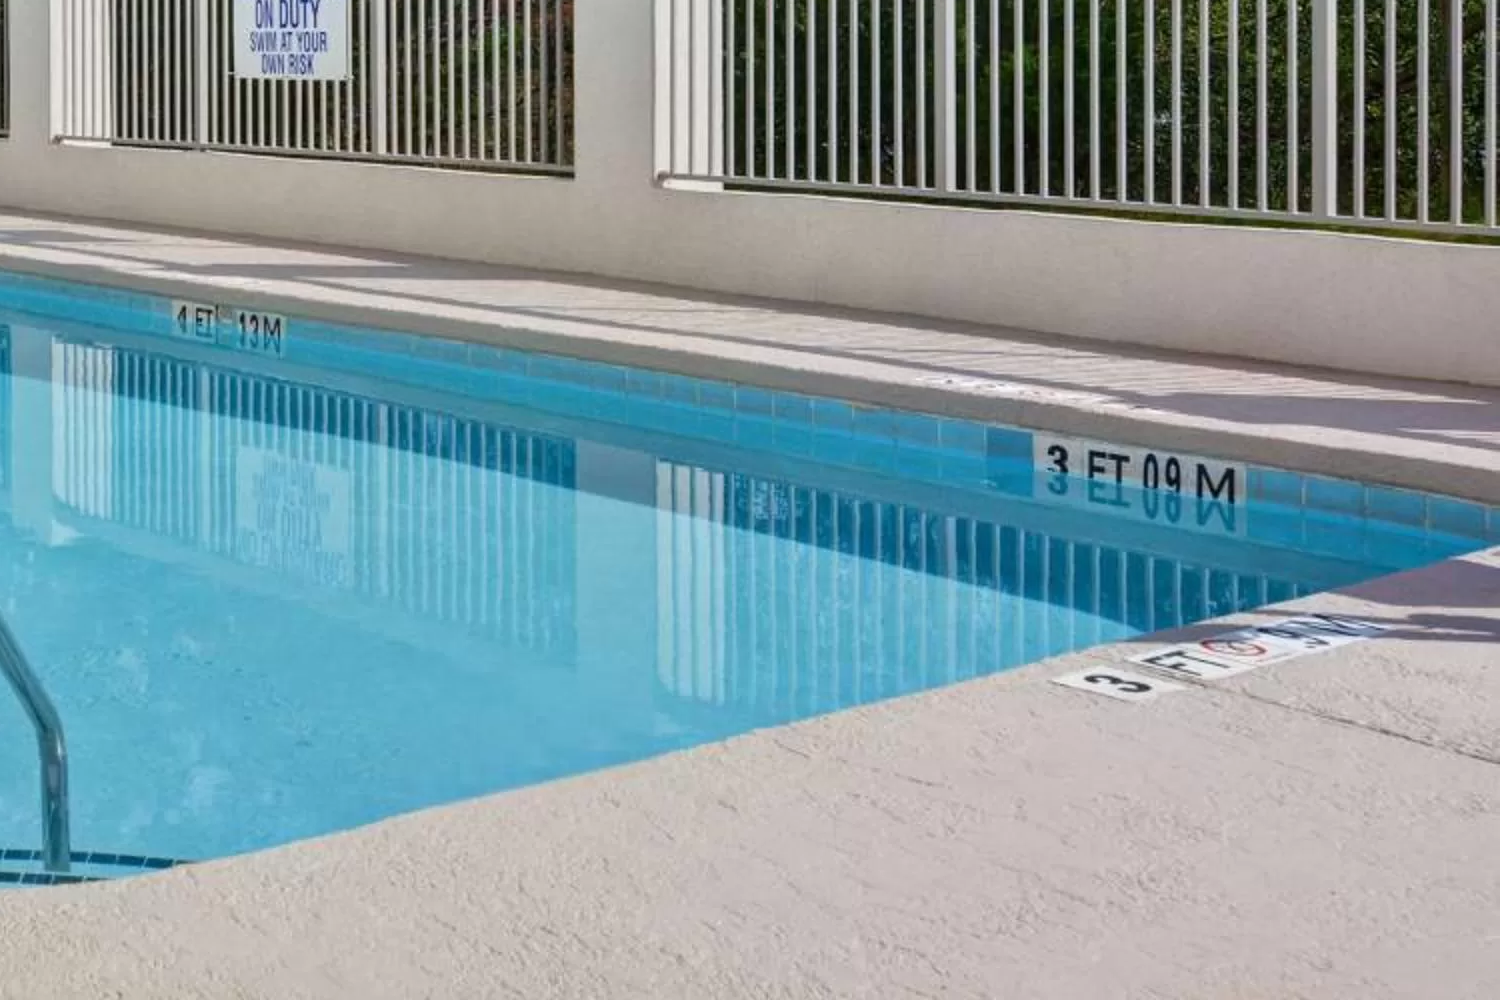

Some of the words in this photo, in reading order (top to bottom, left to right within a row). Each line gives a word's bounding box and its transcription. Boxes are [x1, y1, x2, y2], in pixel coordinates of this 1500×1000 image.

[255, 0, 273, 29] ON
[250, 32, 276, 52] SWIM
[280, 32, 292, 51] AT
[295, 31, 327, 52] YOUR
[261, 54, 284, 74] OWN
[288, 53, 314, 75] RISK
[1047, 444, 1069, 476] 3
[1088, 449, 1130, 486] FT
[1084, 673, 1151, 694] 3
[1141, 649, 1231, 677] FT
